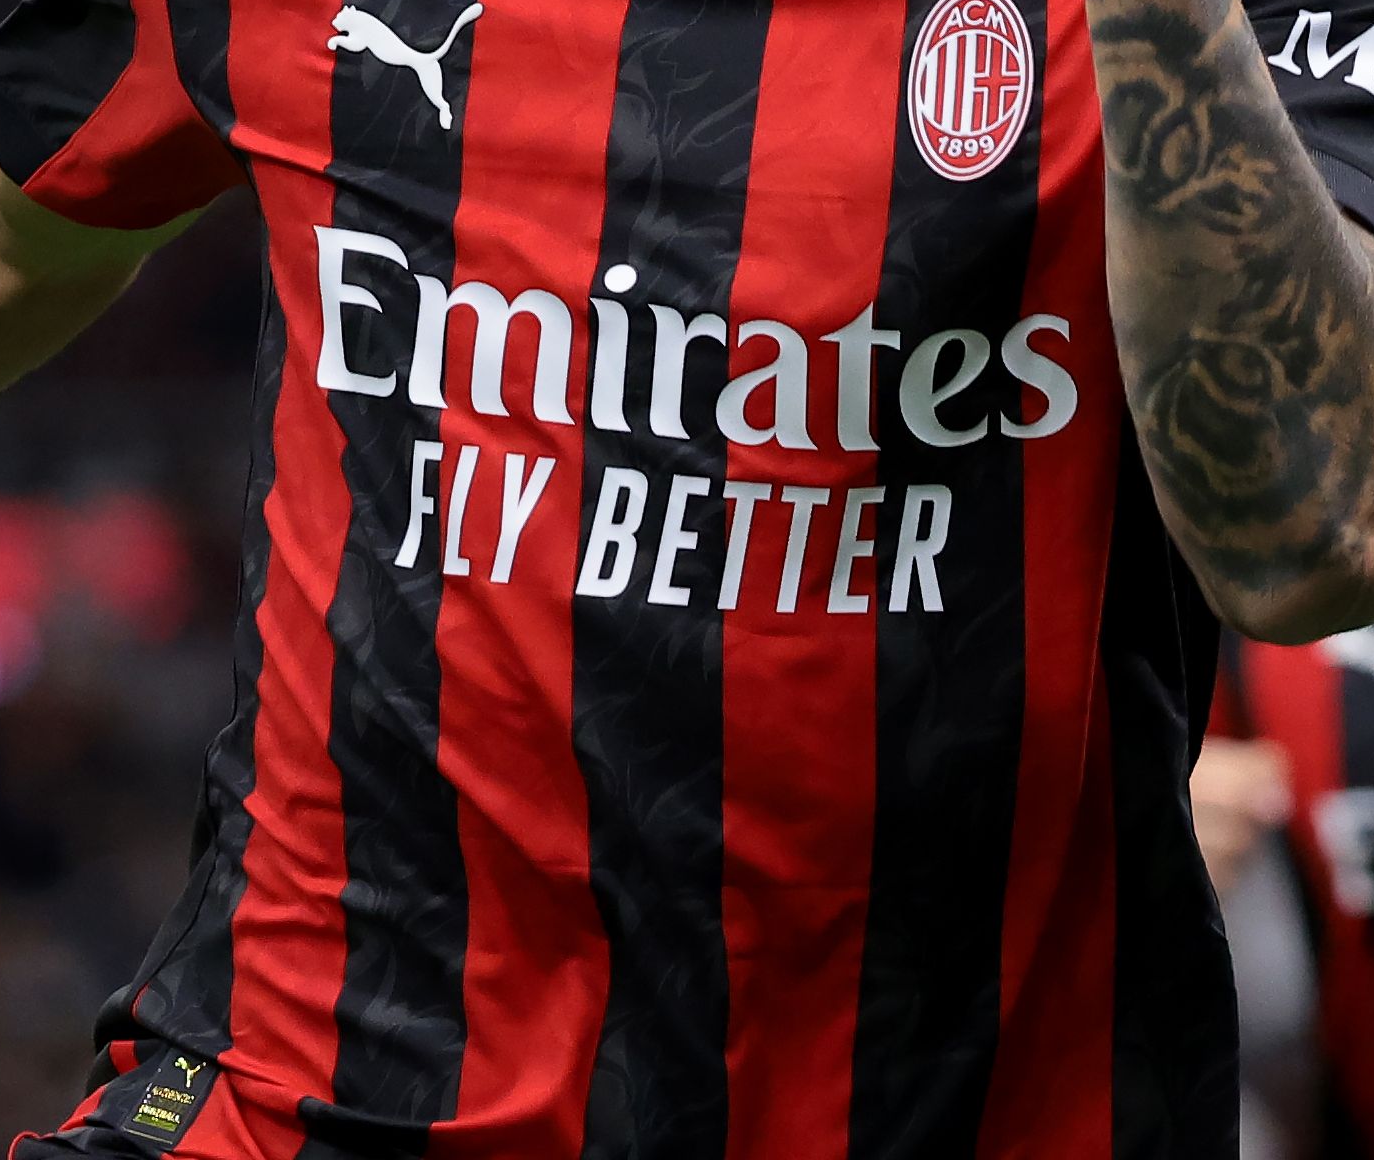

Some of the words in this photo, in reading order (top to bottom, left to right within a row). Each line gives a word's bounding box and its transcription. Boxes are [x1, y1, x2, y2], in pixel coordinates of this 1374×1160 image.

[939, 0, 1008, 38] ACM
[938, 135, 995, 158] 1899
[313, 225, 1079, 451] Emirates
[394, 440, 556, 584] FLY
[575, 466, 953, 614] BETTER
